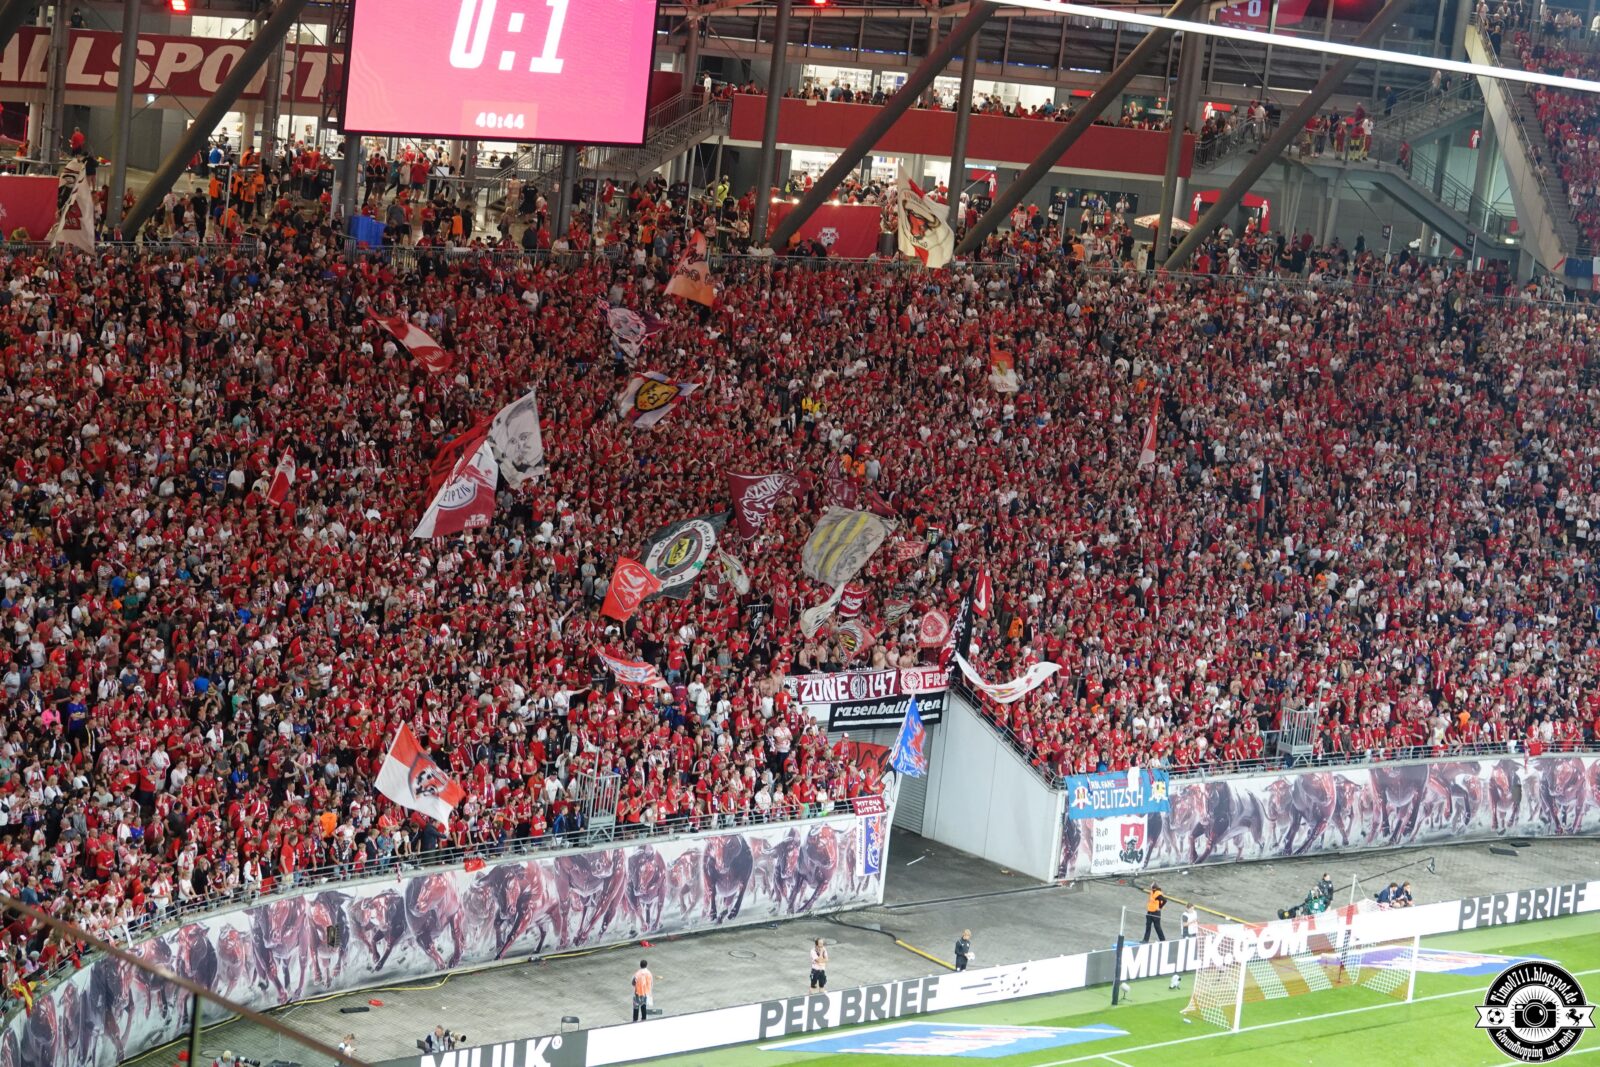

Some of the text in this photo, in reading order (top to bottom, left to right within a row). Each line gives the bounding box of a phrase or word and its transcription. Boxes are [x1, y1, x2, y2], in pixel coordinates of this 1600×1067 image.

[475, 112, 525, 129] 40:44
[443, 484, 471, 502] EIPZIG
[801, 676, 850, 702] ZONE
[869, 671, 897, 698] 147
[835, 699, 941, 718] rasenballiten
[1093, 786, 1144, 810] DELITZSCH
[1458, 882, 1587, 931] PER BRIEF
[759, 976, 939, 1039] PER BRIEF
